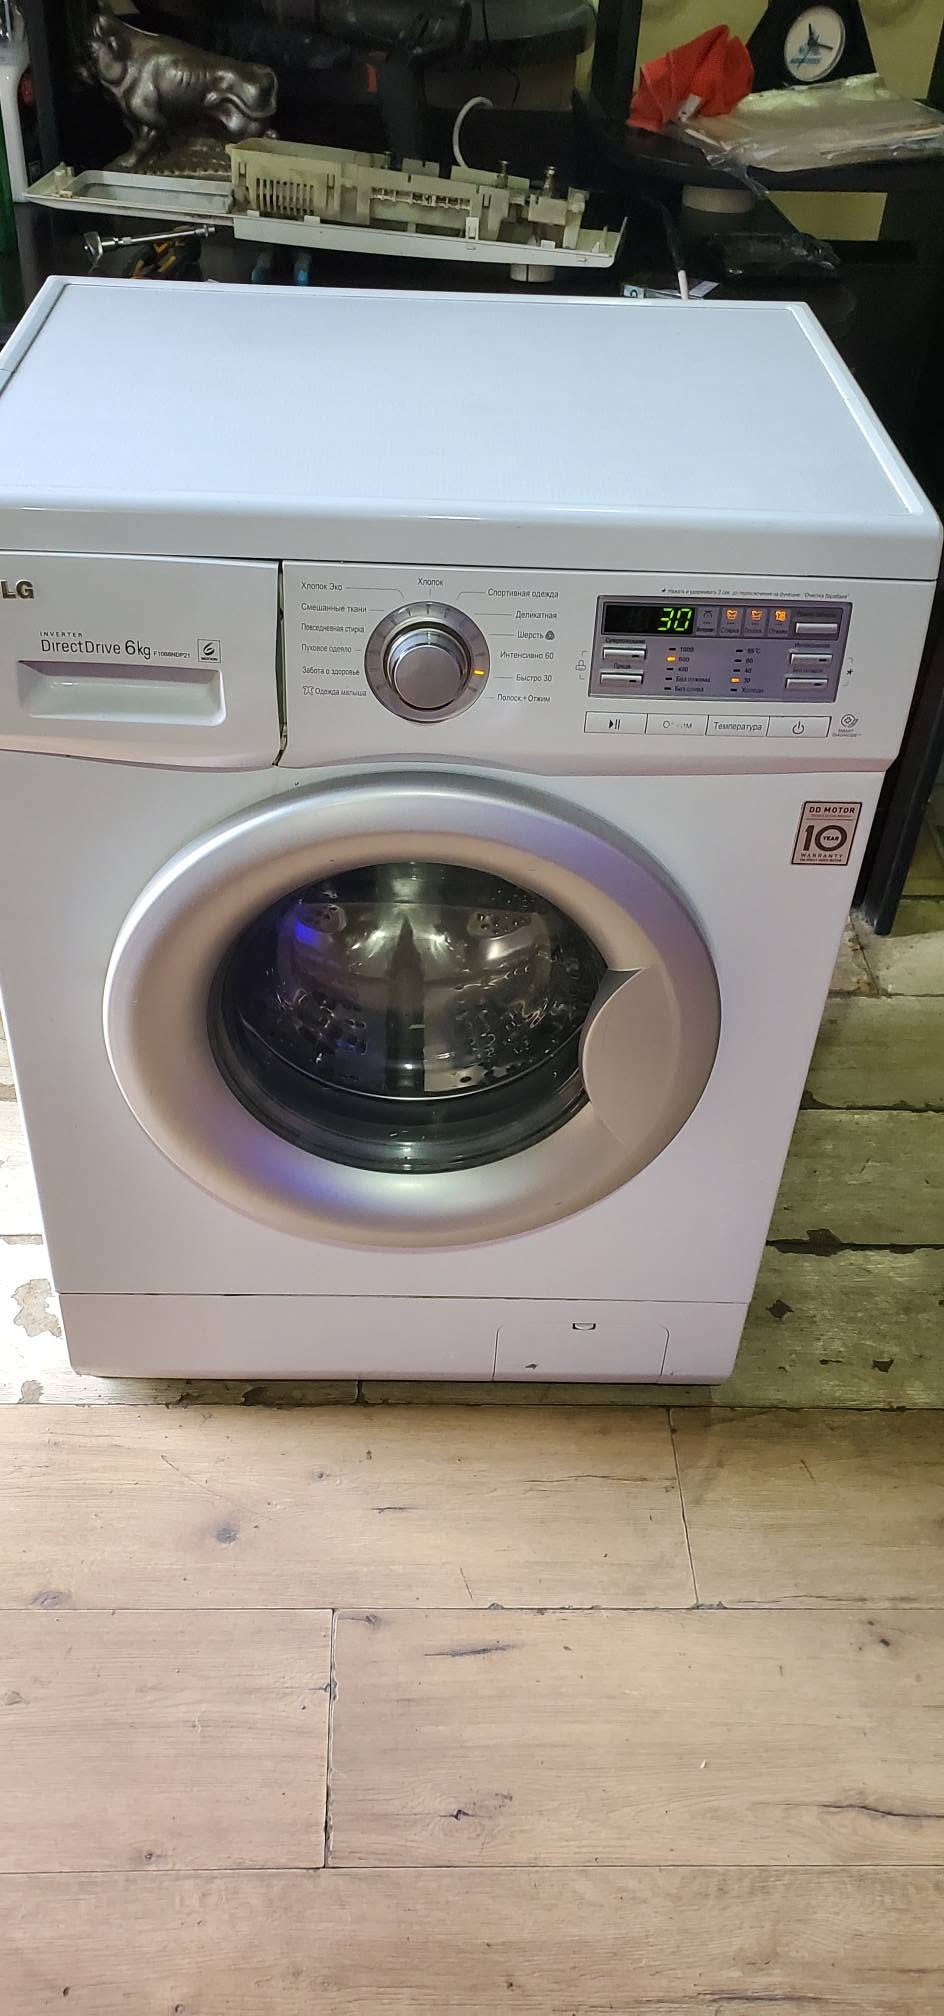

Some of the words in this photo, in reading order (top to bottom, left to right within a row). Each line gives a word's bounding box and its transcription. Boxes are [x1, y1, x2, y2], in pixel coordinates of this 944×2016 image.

[301, 581, 328, 590] Хлопок
[329, 582, 343, 591] Эко
[418, 577, 443, 586] Хлопок
[1, 580, 34, 599] LG
[487, 588, 531, 598] Спортивная
[532, 590, 559, 599] одежда
[301, 602, 345, 612] Смешанные
[346, 605, 367, 613] ткани
[515, 611, 558, 620] Деликатная
[657, 607, 692, 631] 30
[301, 622, 344, 632] Повседневная
[345, 625, 365, 634] стирка
[517, 631, 544, 640] Шерсть
[125, 640, 151, 660] 6kg
[301, 643, 328, 653] Пуховое
[329, 646, 352, 654] одеяло
[499, 651, 543, 660] Интенсивно
[545, 652, 554, 660] 60
[302, 665, 325, 675] Забота
[331, 669, 360, 677] здоровье
[515, 674, 542, 683] Быстро
[543, 674, 553, 682] 30
[314, 687, 340, 696] Одежда
[527, 694, 551, 703] Отжим
[713, 721, 763, 731] Температура
[803, 825, 847, 852] 10
